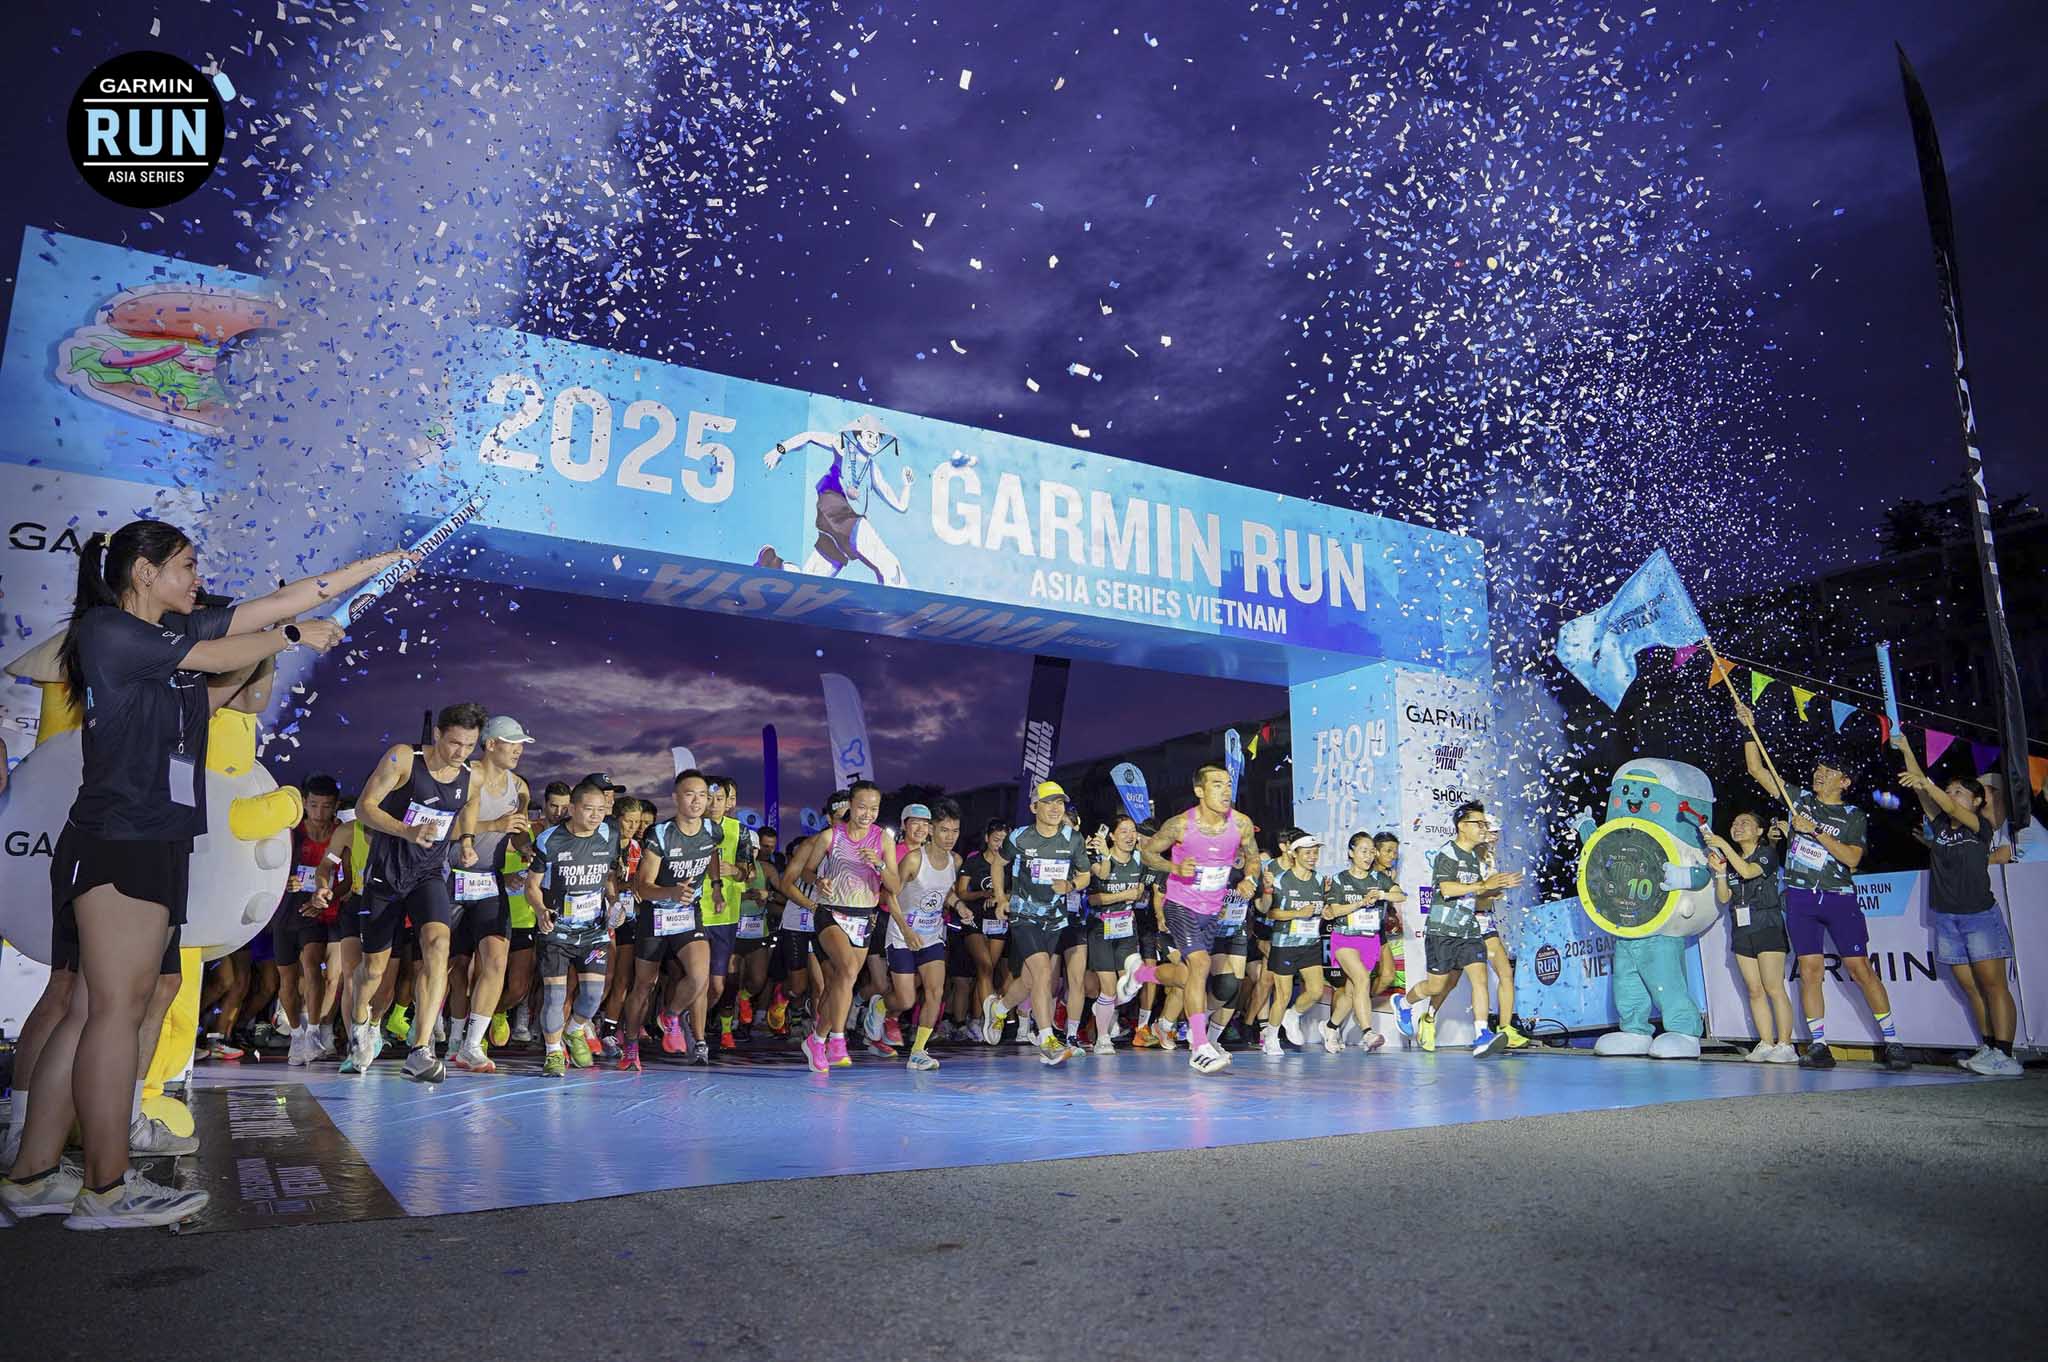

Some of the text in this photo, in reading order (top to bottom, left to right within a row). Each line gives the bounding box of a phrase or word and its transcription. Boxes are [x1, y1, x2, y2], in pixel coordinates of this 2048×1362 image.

[478, 371, 1368, 613] 2025 GARMIN RUN
[378, 561, 410, 592] 2025
[1030, 568, 1288, 636] ASIA SERIES VIETNAM
[1406, 704, 1489, 732] GARMIN
[1023, 720, 1042, 771] VITAL
[1313, 718, 1386, 769] FROM
[1435, 744, 1464, 759] amino
[1436, 757, 1457, 771] VITAL
[1820, 823, 1841, 837] ZERO
[559, 863, 609, 877] FROM ZERO
[669, 859, 694, 871] FROM
[673, 868, 685, 878] TO
[565, 873, 602, 886] TO HERO
[1107, 882, 1126, 892] FROM
[1627, 878, 1653, 900] 10
[1855, 882, 1892, 895] IN RUN
[1565, 940, 1593, 959] 2025
[1537, 957, 1559, 974] RUN
